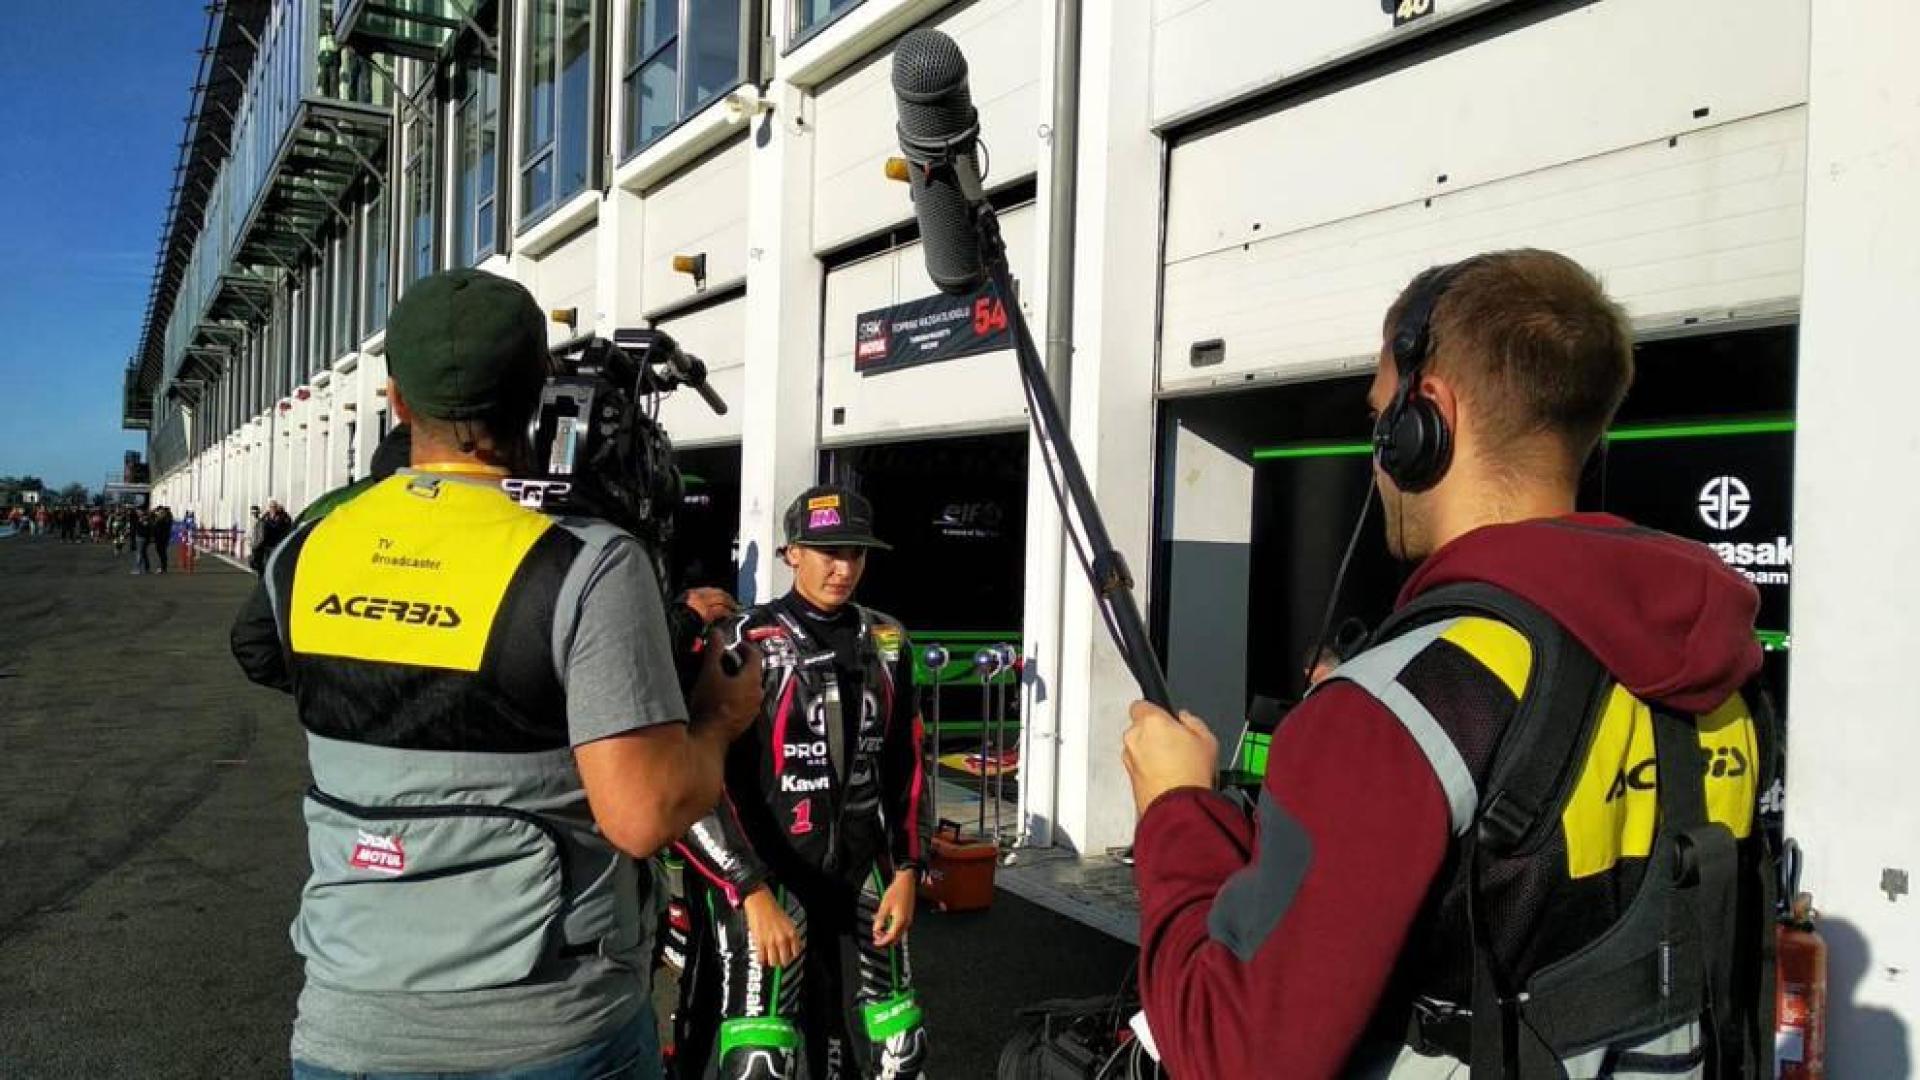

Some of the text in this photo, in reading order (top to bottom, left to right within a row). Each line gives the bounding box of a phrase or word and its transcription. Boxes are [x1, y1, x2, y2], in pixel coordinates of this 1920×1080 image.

[972, 297, 1008, 335] 54
[377, 538, 394, 550] TV
[1707, 536, 1793, 565] asak
[370, 553, 442, 571] Broadcaster
[314, 592, 462, 628] ACERBIS
[783, 740, 827, 759] PRO
[1605, 746, 1748, 802] ACIS
[790, 798, 813, 834] 1
[356, 848, 401, 867] MOTUL
